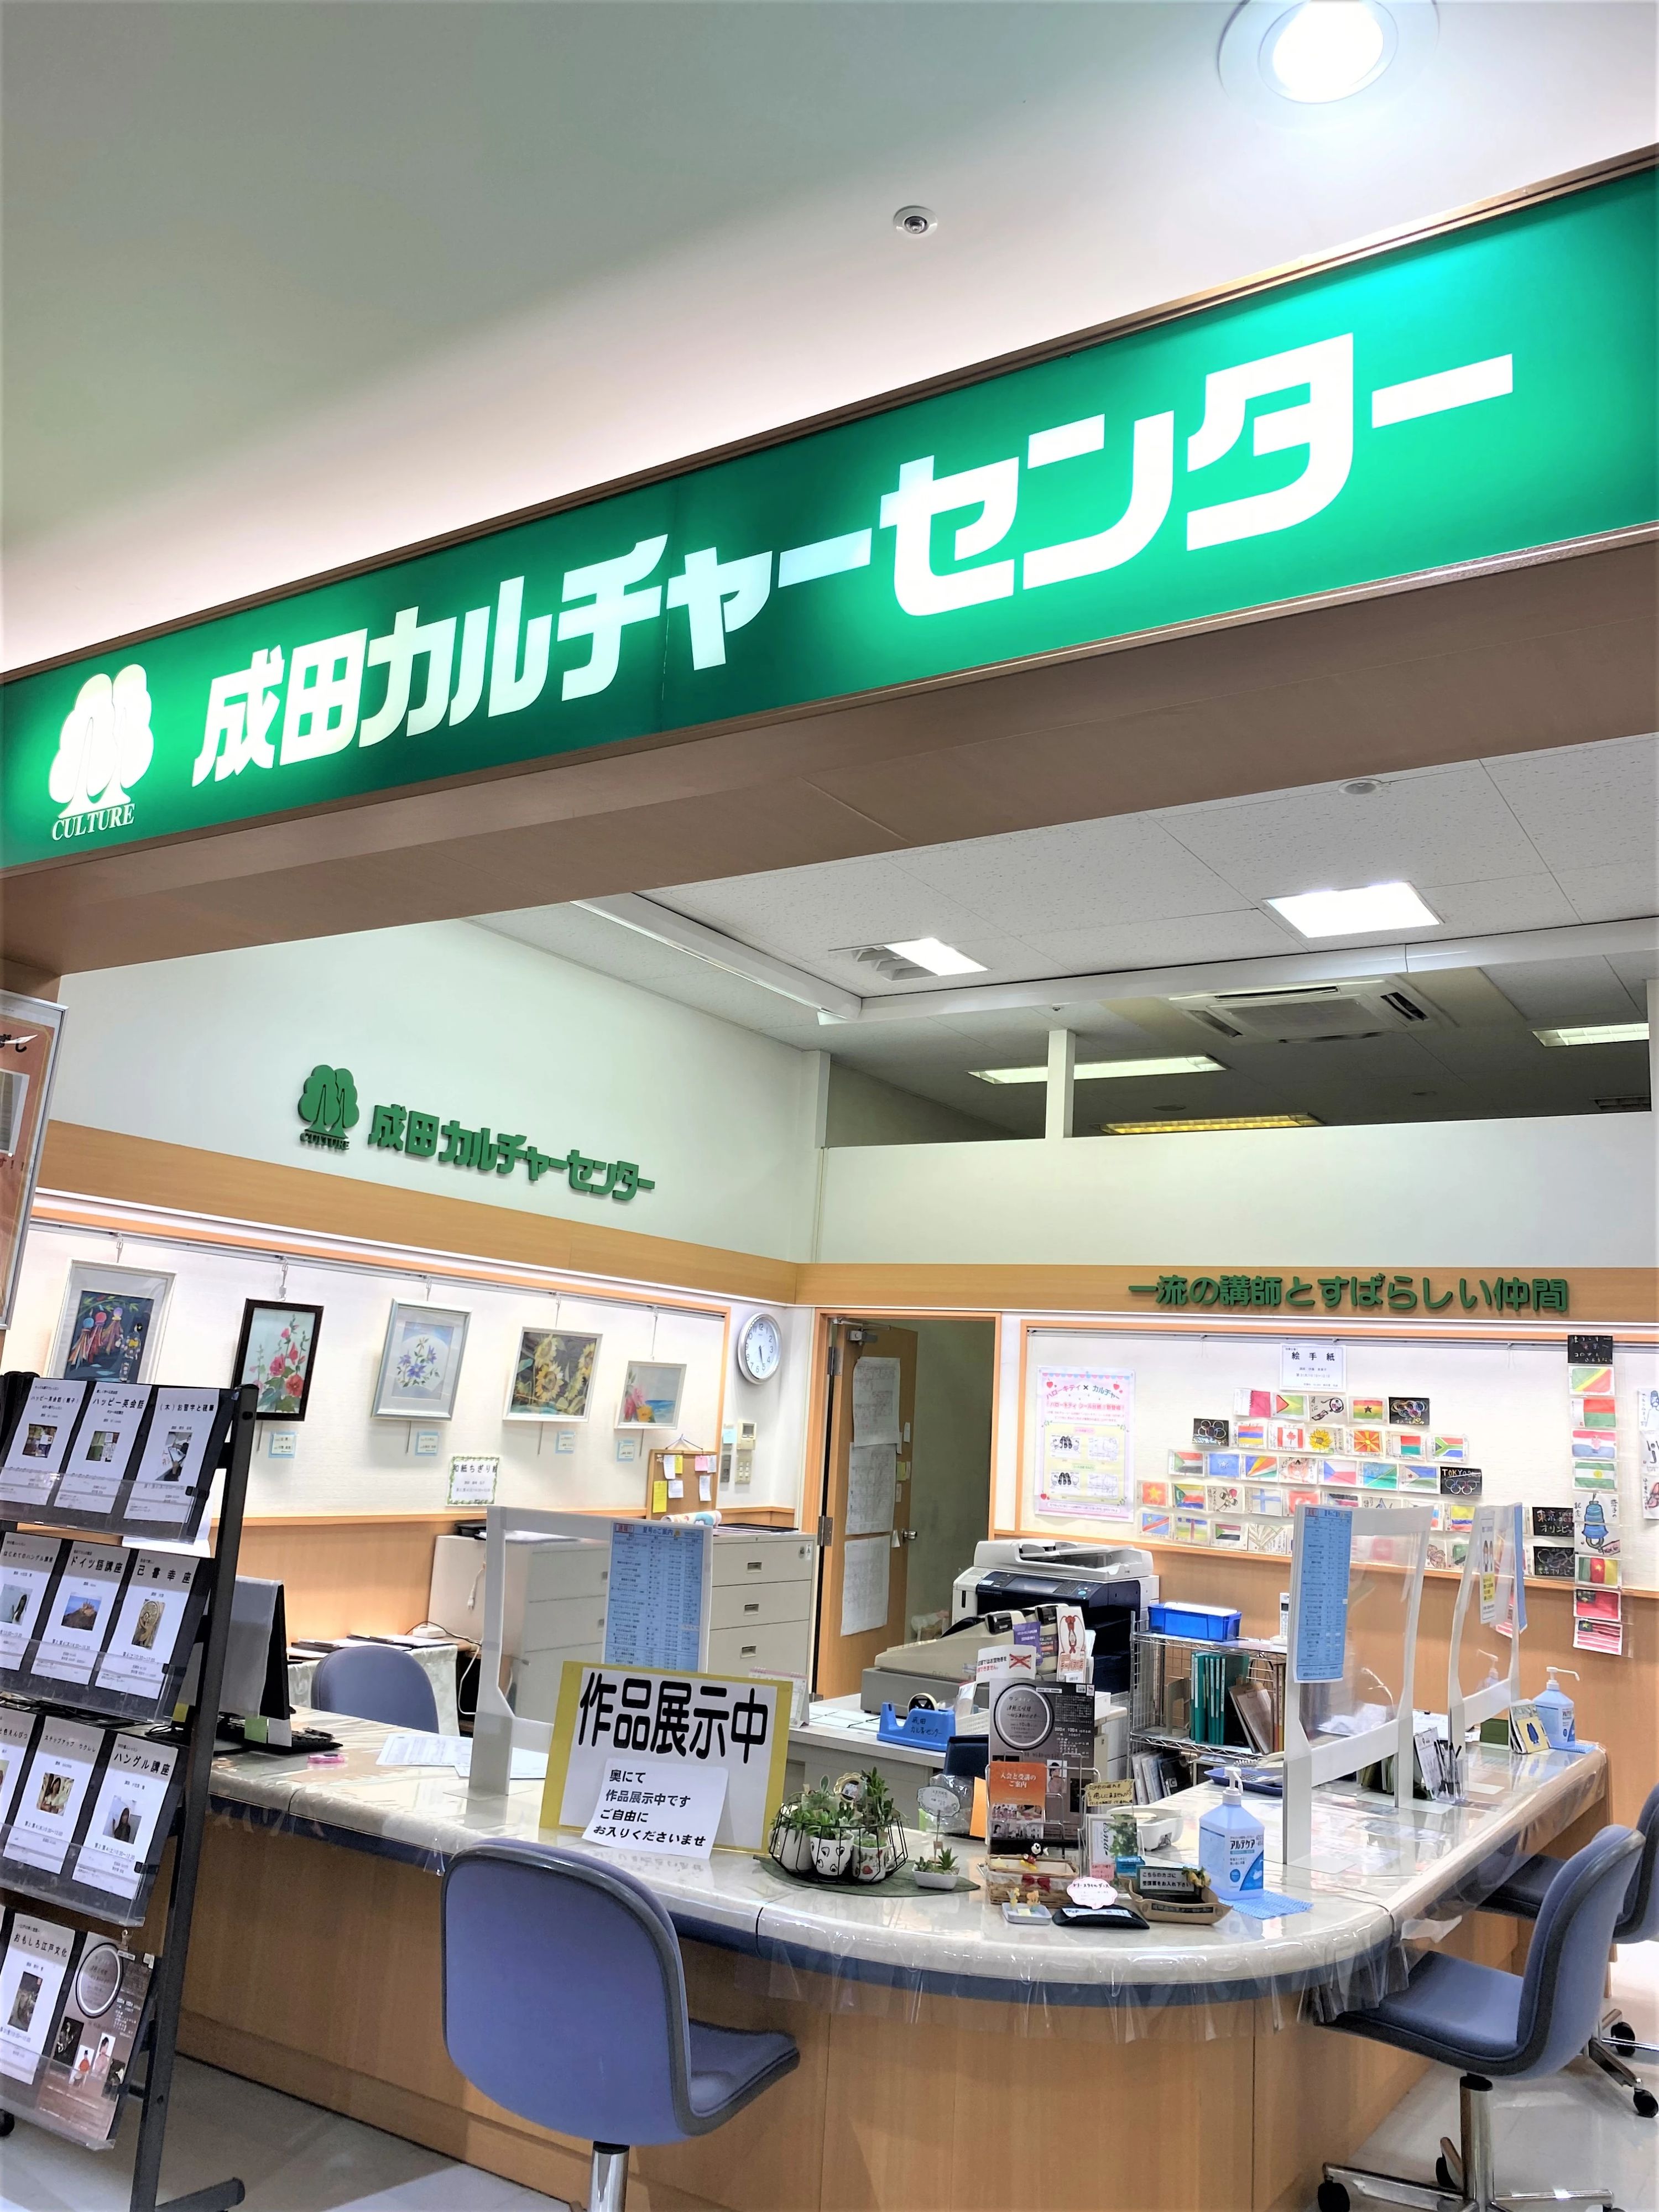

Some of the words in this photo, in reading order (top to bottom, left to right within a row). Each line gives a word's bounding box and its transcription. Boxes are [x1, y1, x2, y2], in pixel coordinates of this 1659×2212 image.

[191, 333, 1514, 787] 成田カルチャーセンター
[51, 803, 135, 841] CULTURE
[300, 1132, 350, 1151] CULTURE
[367, 1104, 656, 1201] 成田カルチャーセンター
[1129, 1273, 1569, 1312] 一流の講師とすばらしい仲間
[1291, 1352, 1335, 1361] 絵手紙
[1046, 1384, 1081, 1400] ハローキティ
[1092, 1385, 1120, 1400] カルチャー
[92, 1397, 145, 1409] ハッピー英会話
[1442, 1468, 1466, 1477] TOKYO
[1537, 1510, 1556, 1522] 東京
[1540, 1524, 1574, 1534] オリンピッ
[70, 1556, 123, 1574] ドイツ語講座
[137, 1564, 192, 1584] 己書幸座
[577, 1672, 769, 1764] 作品展示中
[911, 1717, 926, 1725] 成田
[113, 1752, 171, 1776] ハングル講座
[609, 1768, 646, 1784] 奥にて
[1000, 1772, 1037, 1781] 入会と受講の
[1009, 1780, 1027, 1788] ご案内
[606, 1789, 691, 1808] 作品展示中です
[600, 1808, 648, 1823] ご自由に
[593, 1824, 707, 1847] お入りくださいませ
[1229, 1839, 1255, 1850] アルテケア
[14, 1933, 67, 1957] おもしろ江戸文化
